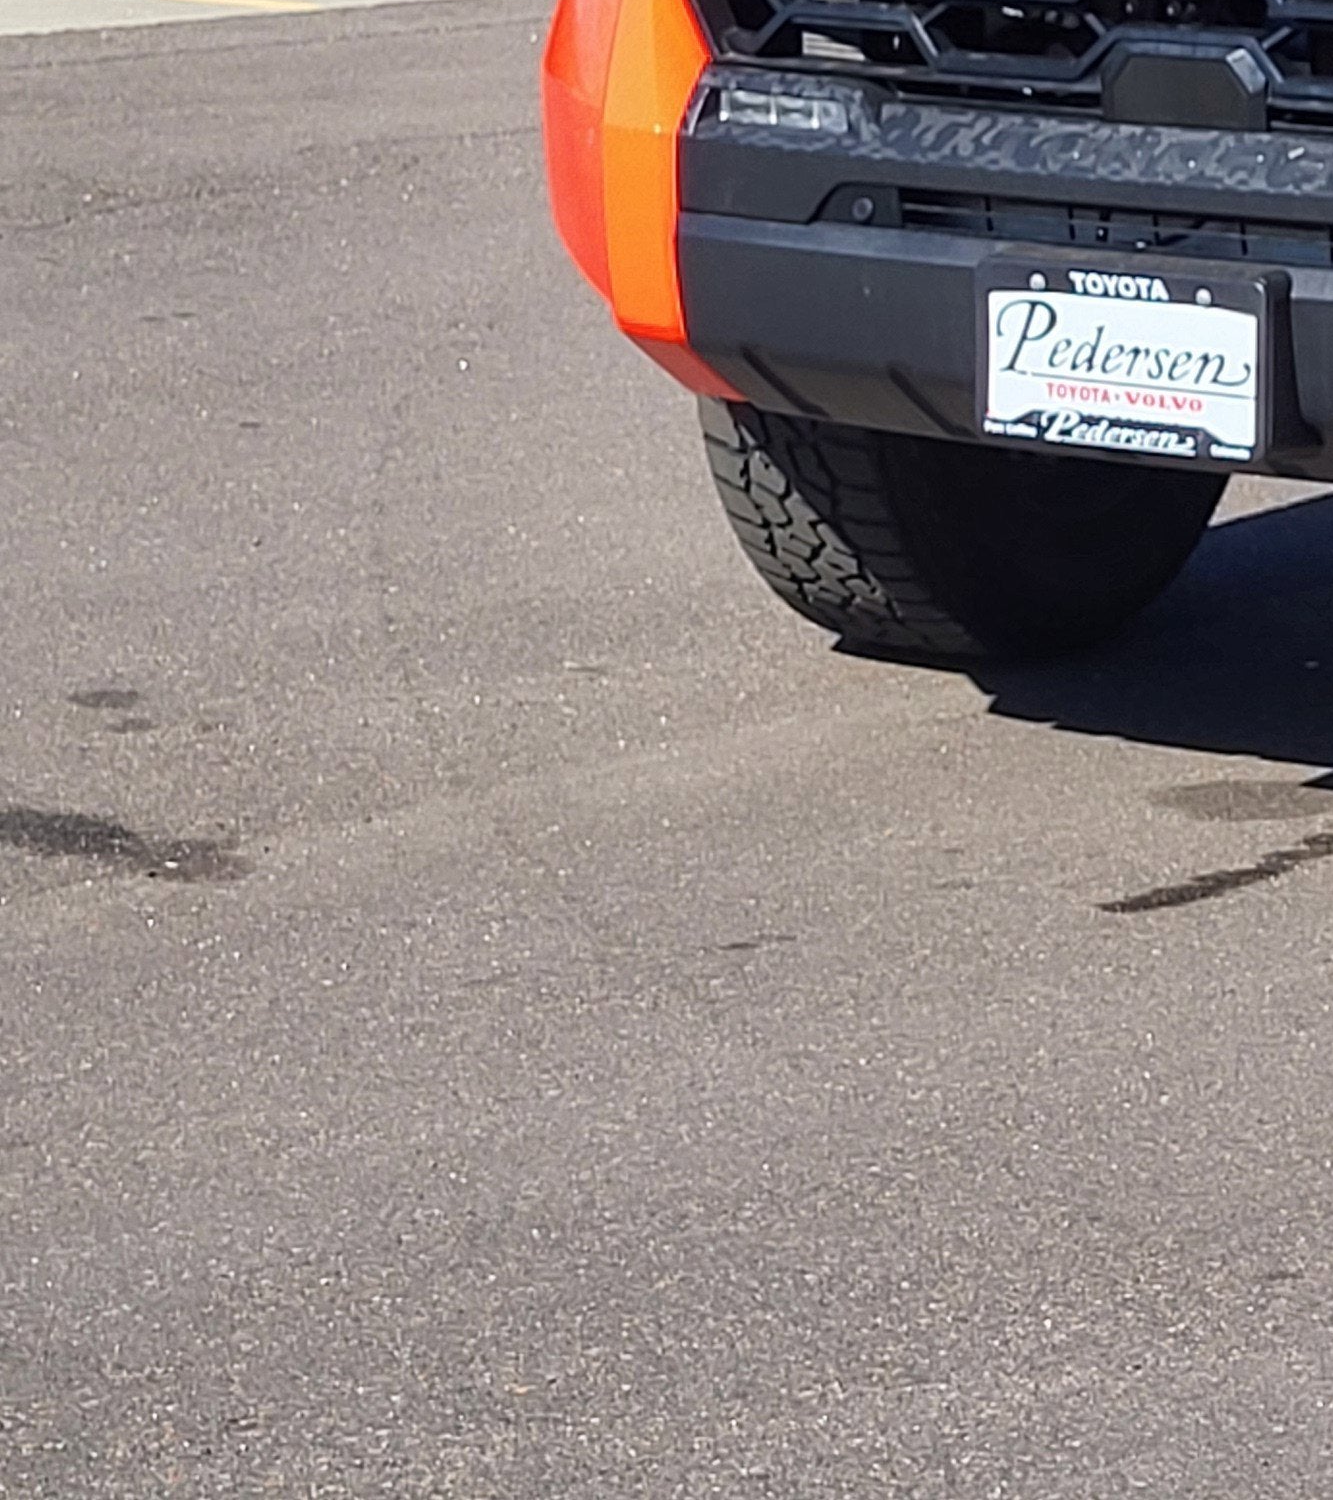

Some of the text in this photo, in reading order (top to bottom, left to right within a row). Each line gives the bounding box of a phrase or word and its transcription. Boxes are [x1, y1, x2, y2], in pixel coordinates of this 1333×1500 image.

[1069, 271, 1169, 300] TOYOTA
[995, 298, 1253, 388] Pedersen
[1046, 382, 1203, 411] TOYOTA VOLVO
[1040, 408, 1197, 457] Pedersen
